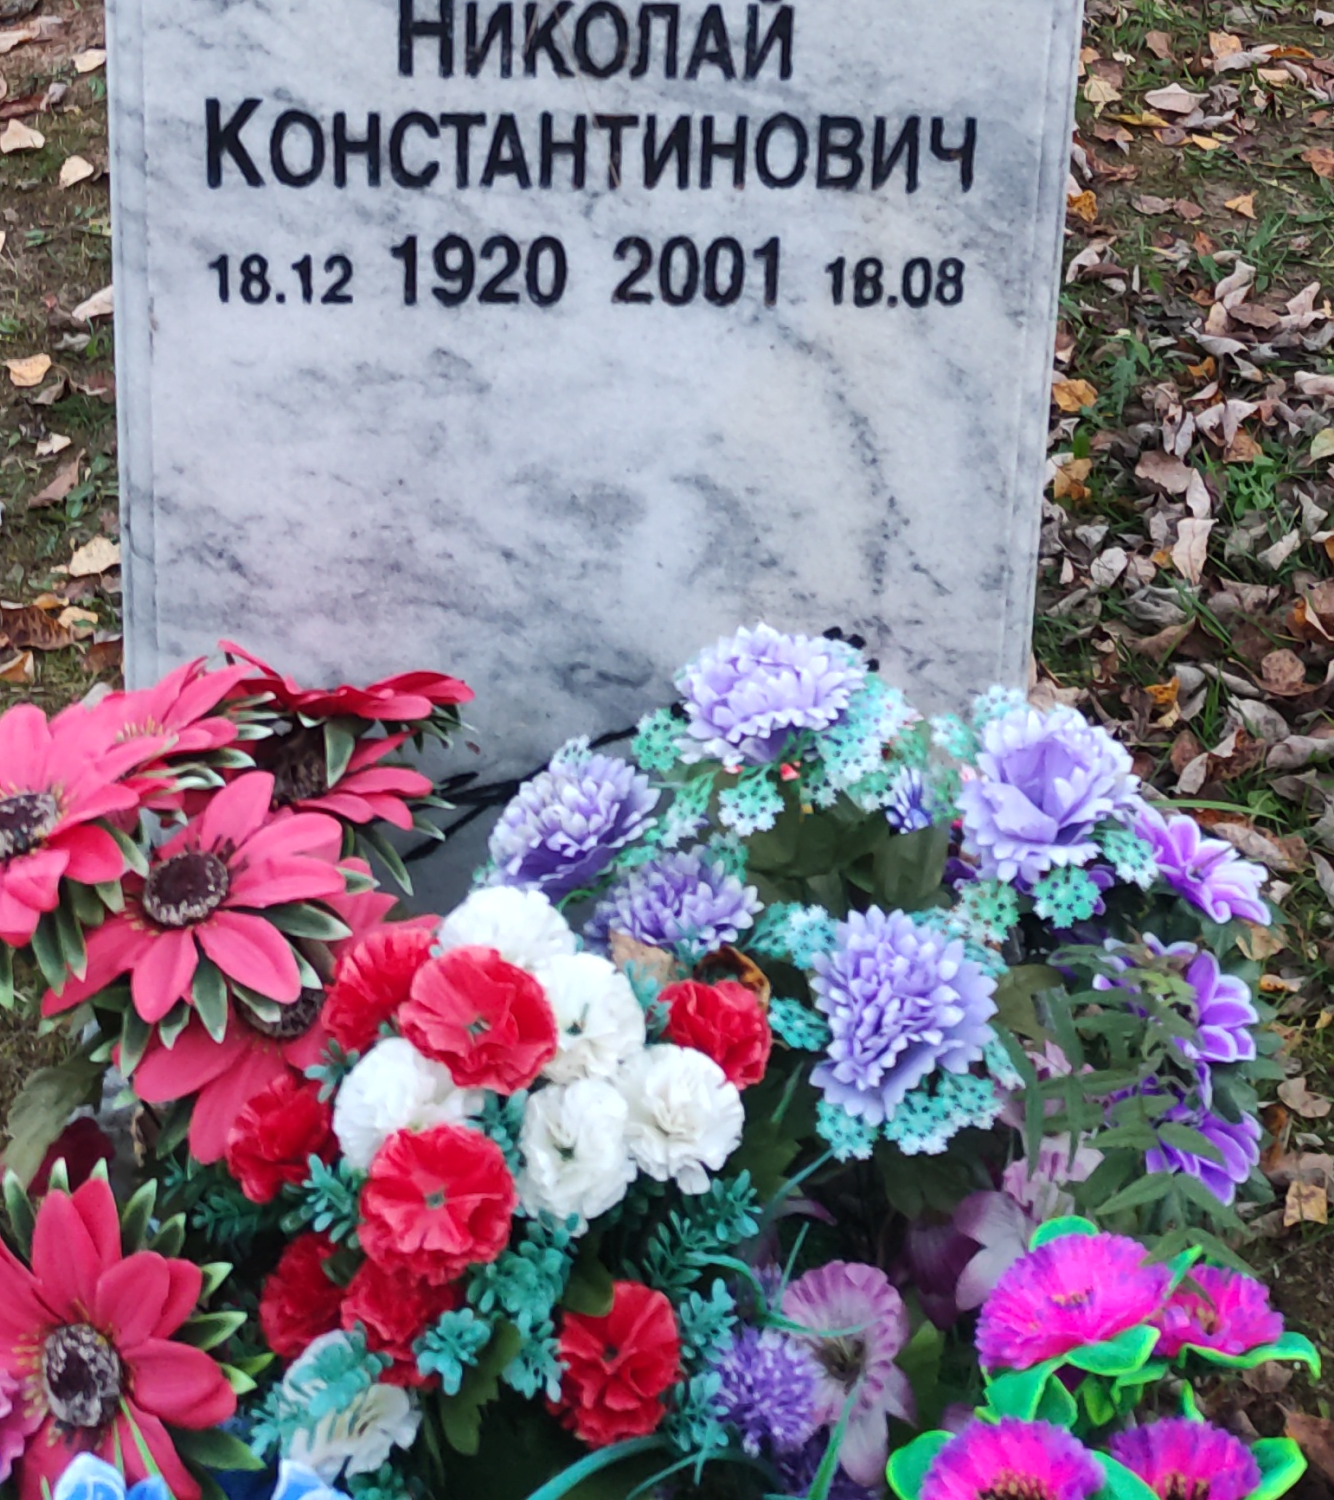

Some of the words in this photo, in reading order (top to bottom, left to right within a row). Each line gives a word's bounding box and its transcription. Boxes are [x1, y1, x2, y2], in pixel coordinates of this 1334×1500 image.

[208, 253, 354, 304] 18.12
[390, 235, 569, 306] 1920
[611, 235, 781, 308] 2001
[824, 257, 966, 308] 18.08
